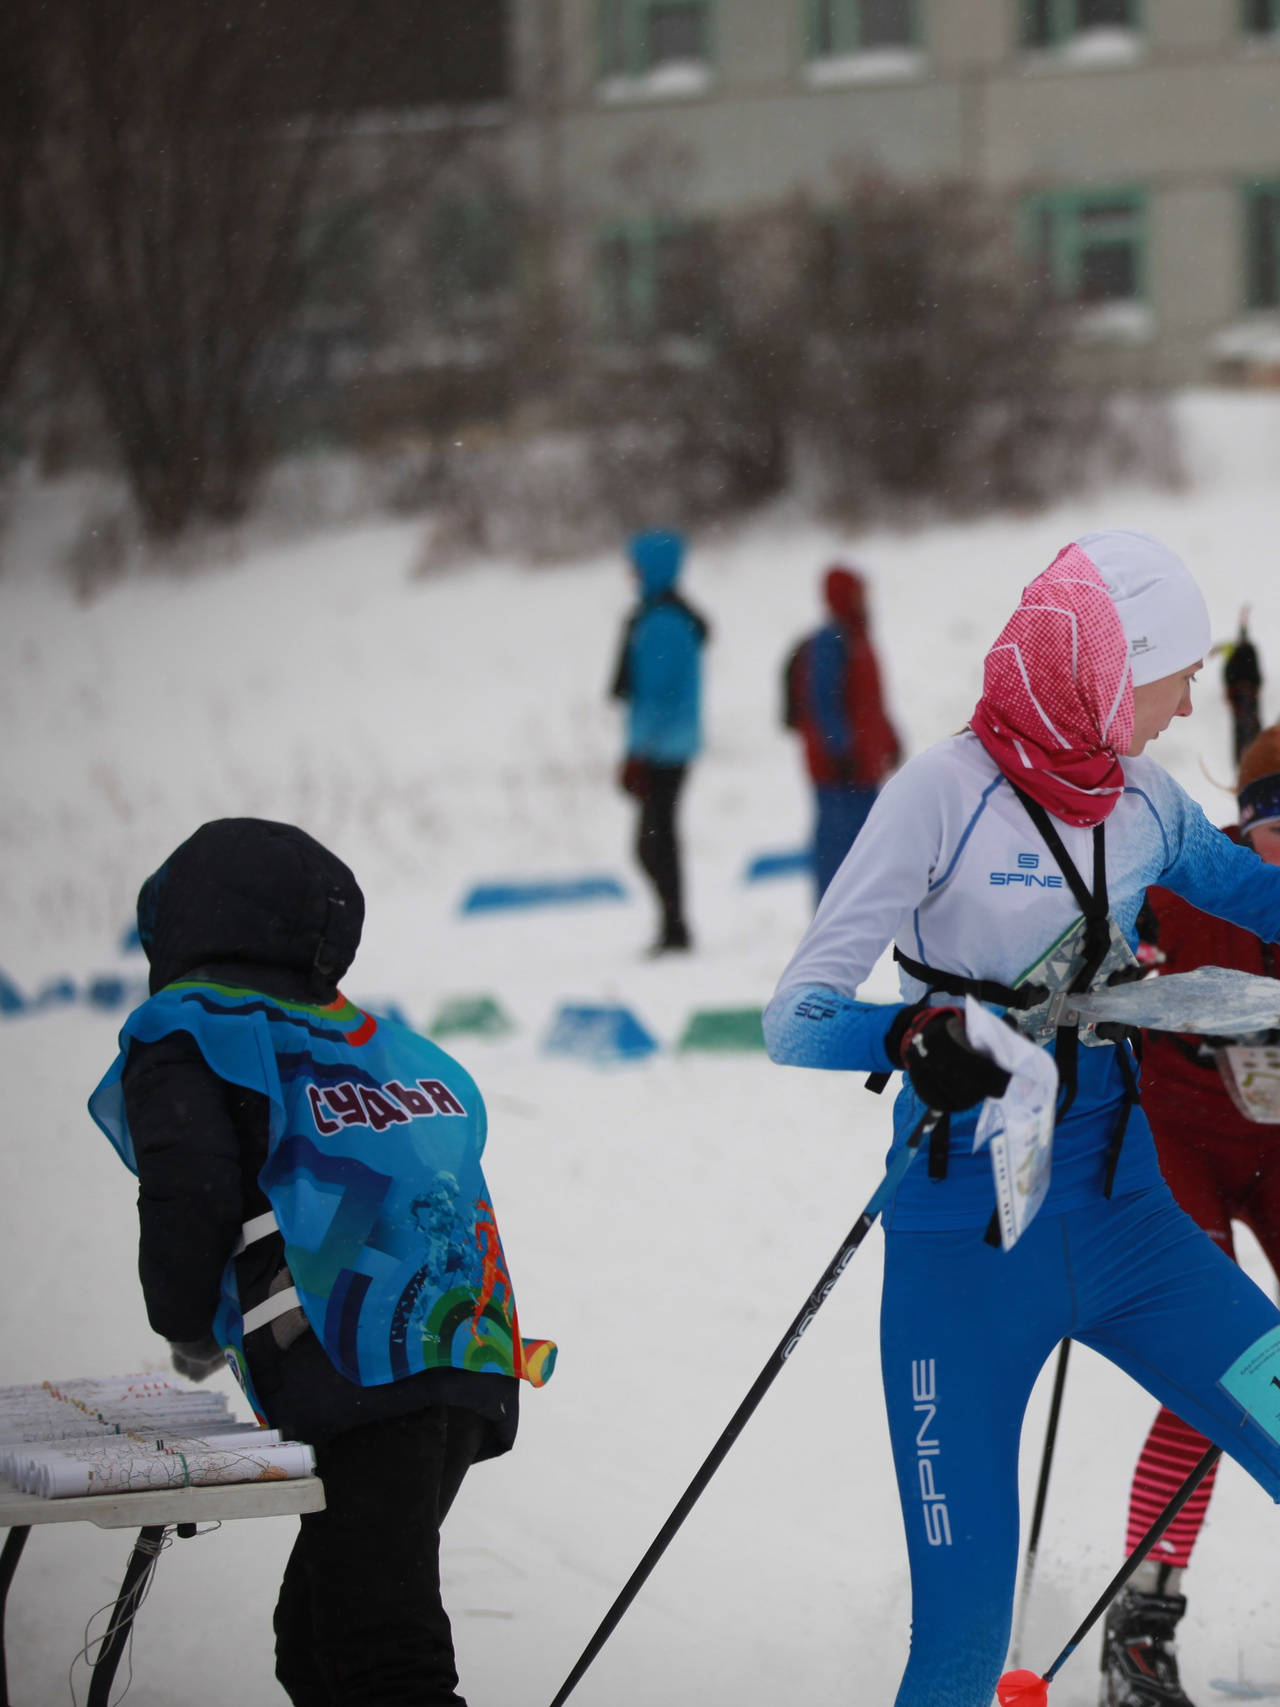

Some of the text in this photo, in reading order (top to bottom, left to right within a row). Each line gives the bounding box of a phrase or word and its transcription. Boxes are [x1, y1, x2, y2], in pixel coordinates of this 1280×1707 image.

[990, 872, 1063, 888] SPINE
[306, 1079, 468, 1136] СУДЬЯ
[912, 1358, 953, 1546] SPINE
